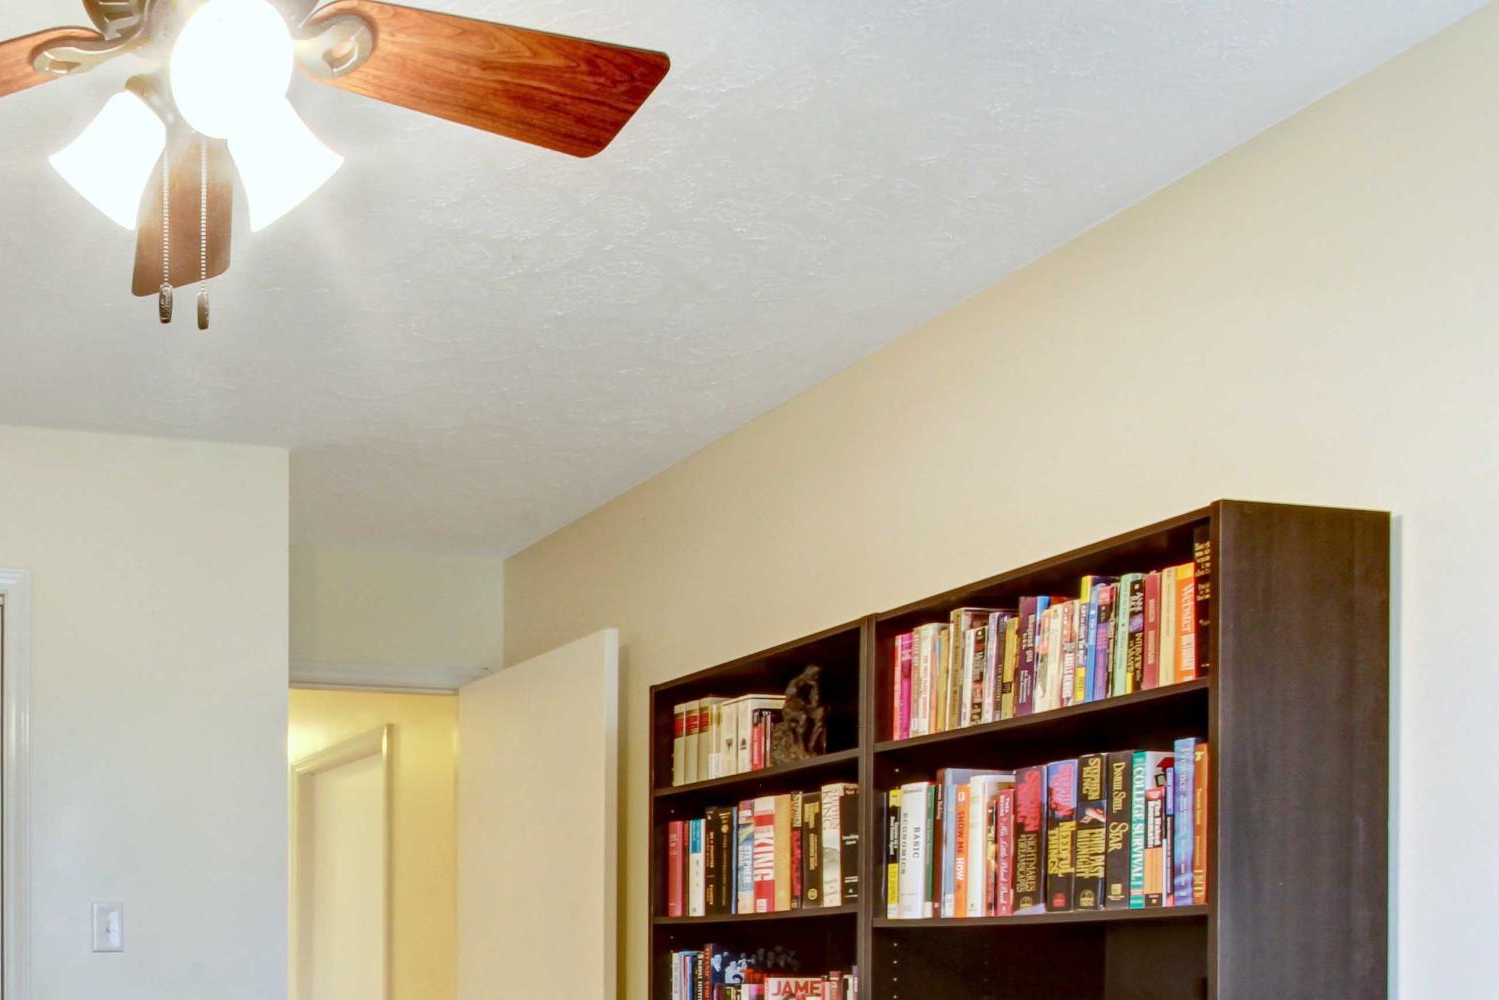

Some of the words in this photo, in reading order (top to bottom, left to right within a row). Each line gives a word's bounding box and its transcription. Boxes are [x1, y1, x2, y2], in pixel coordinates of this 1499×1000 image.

[1133, 766, 1144, 820] COLLEGE
[753, 835, 775, 882] KING
[900, 812, 908, 875] ECONOMICS
[912, 826, 921, 859] BASIC
[1048, 827, 1059, 875] THINGS
[1058, 820, 1077, 878] NEEDFUL
[1108, 821, 1129, 853] STAR
[1132, 823, 1144, 881] SURVIVAL
